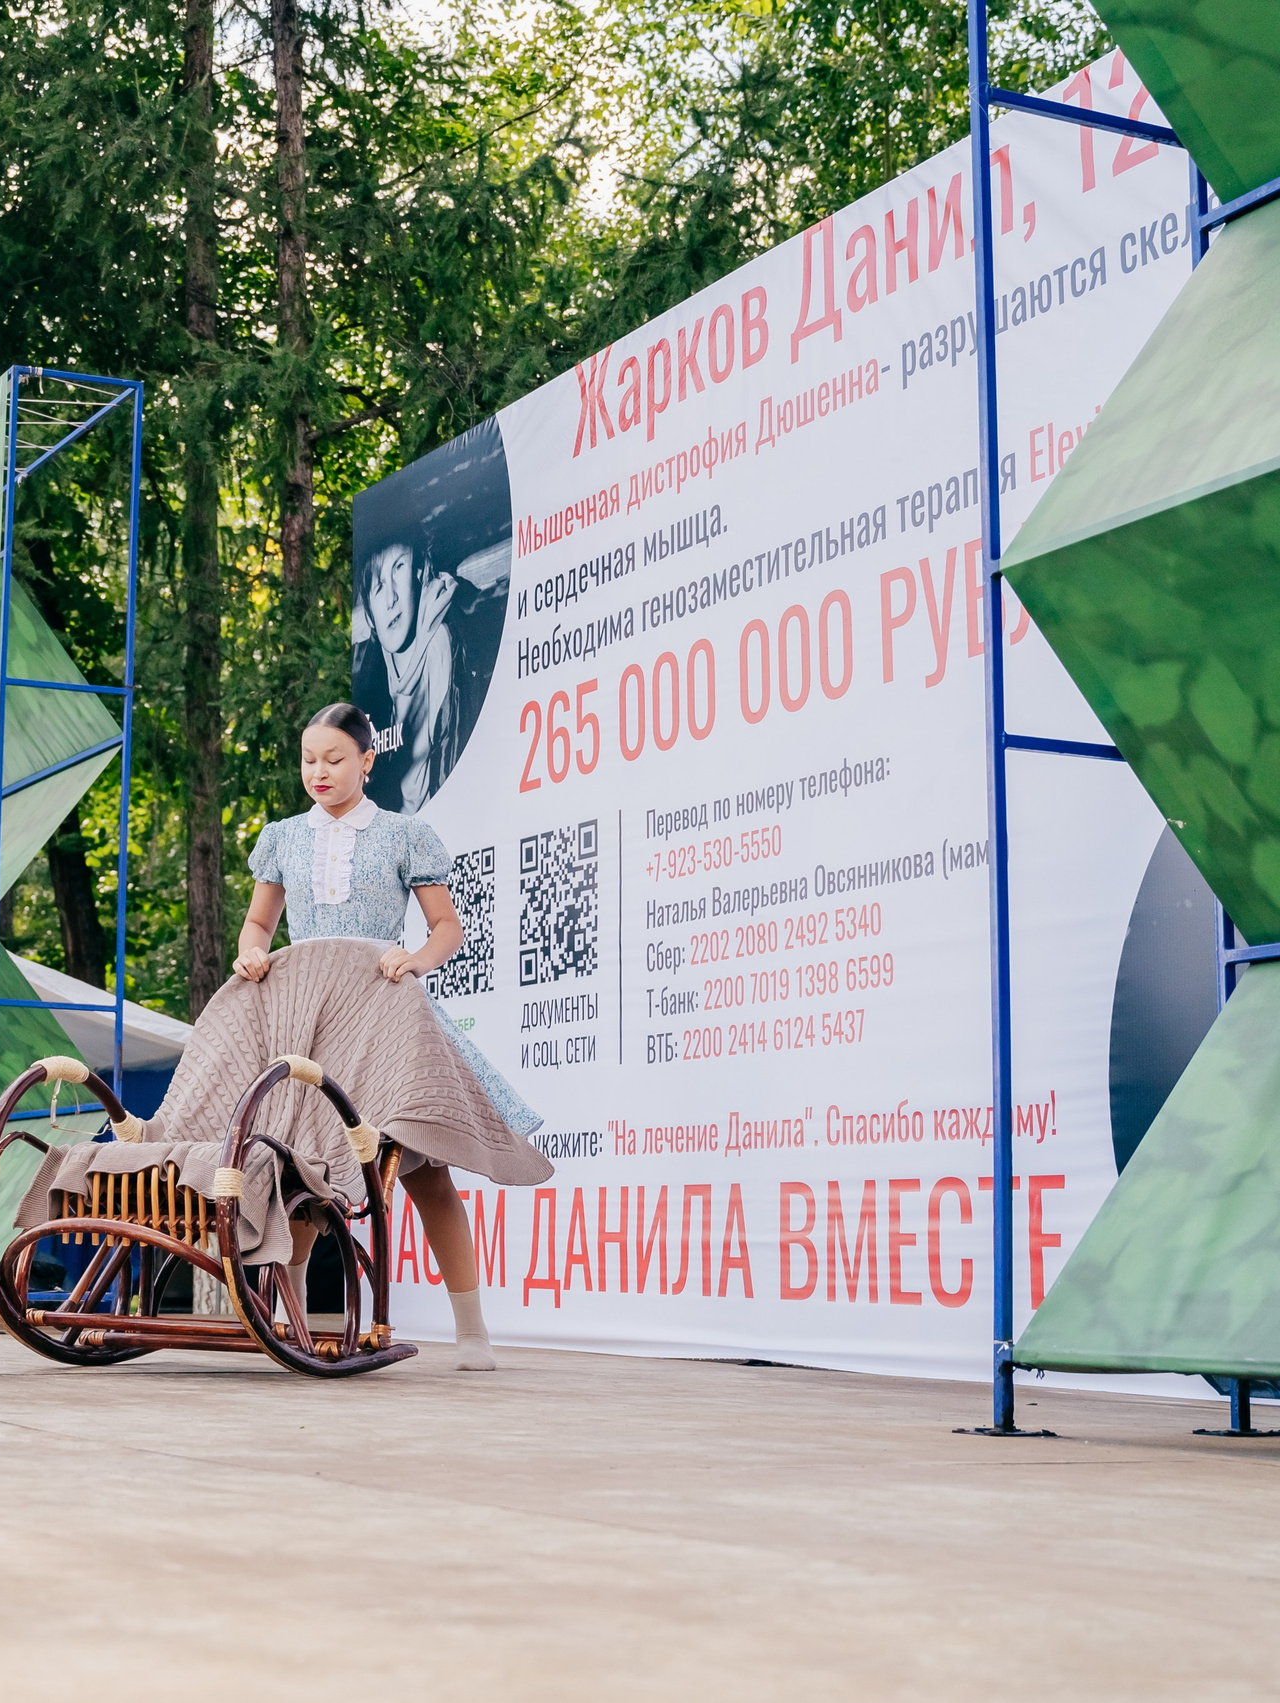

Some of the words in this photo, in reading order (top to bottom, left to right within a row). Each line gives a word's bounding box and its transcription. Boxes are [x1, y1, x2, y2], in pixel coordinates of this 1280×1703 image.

[573, 285, 769, 459] Жарков
[518, 484, 620, 559] Мышечная
[626, 421, 747, 517] дистрофия
[756, 357, 890, 455] Дюшенна-
[518, 588, 527, 620] и
[534, 541, 636, 613] сердечная
[643, 504, 728, 567] мышца.
[518, 607, 634, 679] Необходима
[642, 504, 888, 632] генозаместительная
[896, 452, 1017, 533] терапя
[519, 678, 600, 794] 265
[620, 638, 716, 762] 000
[740, 588, 854, 725] 000
[646, 803, 709, 841] Перевод
[713, 797, 731, 823] по
[736, 779, 794, 817] номеру
[799, 756, 890, 802] телефона:
[646, 824, 782, 883] +7-923-530-5550
[646, 896, 706, 929] Наталья
[712, 877, 808, 918] Валерьевна
[814, 851, 934, 898] Овсянникова
[942, 838, 990, 880] (мам
[646, 941, 685, 975] Сбер:
[690, 929, 730, 965] 2202
[735, 921, 777, 958] 2080
[784, 912, 828, 950] 2492
[835, 902, 881, 942] 5340
[454, 1017, 476, 1031] БЕР
[521, 993, 598, 1033] ДОКУМЕНТЫ
[646, 986, 698, 1018] Т-банк:
[704, 975, 744, 1010] 2200
[750, 968, 789, 1004] 7019
[796, 961, 839, 998] 1398
[846, 952, 894, 991] 6599
[521, 1043, 529, 1069] И
[533, 1040, 562, 1070] СОЦ.
[566, 1035, 596, 1064] СЕТИ
[646, 1032, 678, 1064] ВТБ:
[683, 1026, 722, 1060] 2200
[728, 1021, 767, 1056] 2414
[773, 1015, 815, 1051] 6124
[822, 1009, 865, 1046] 5437
[534, 1131, 603, 1158] укажите:
[607, 1120, 637, 1156] "На
[642, 1121, 719, 1155] лечение
[826, 1099, 924, 1147] Спасибо
[933, 1089, 1057, 1147] каждму!
[523, 1183, 754, 1309] ДАНИЛА
